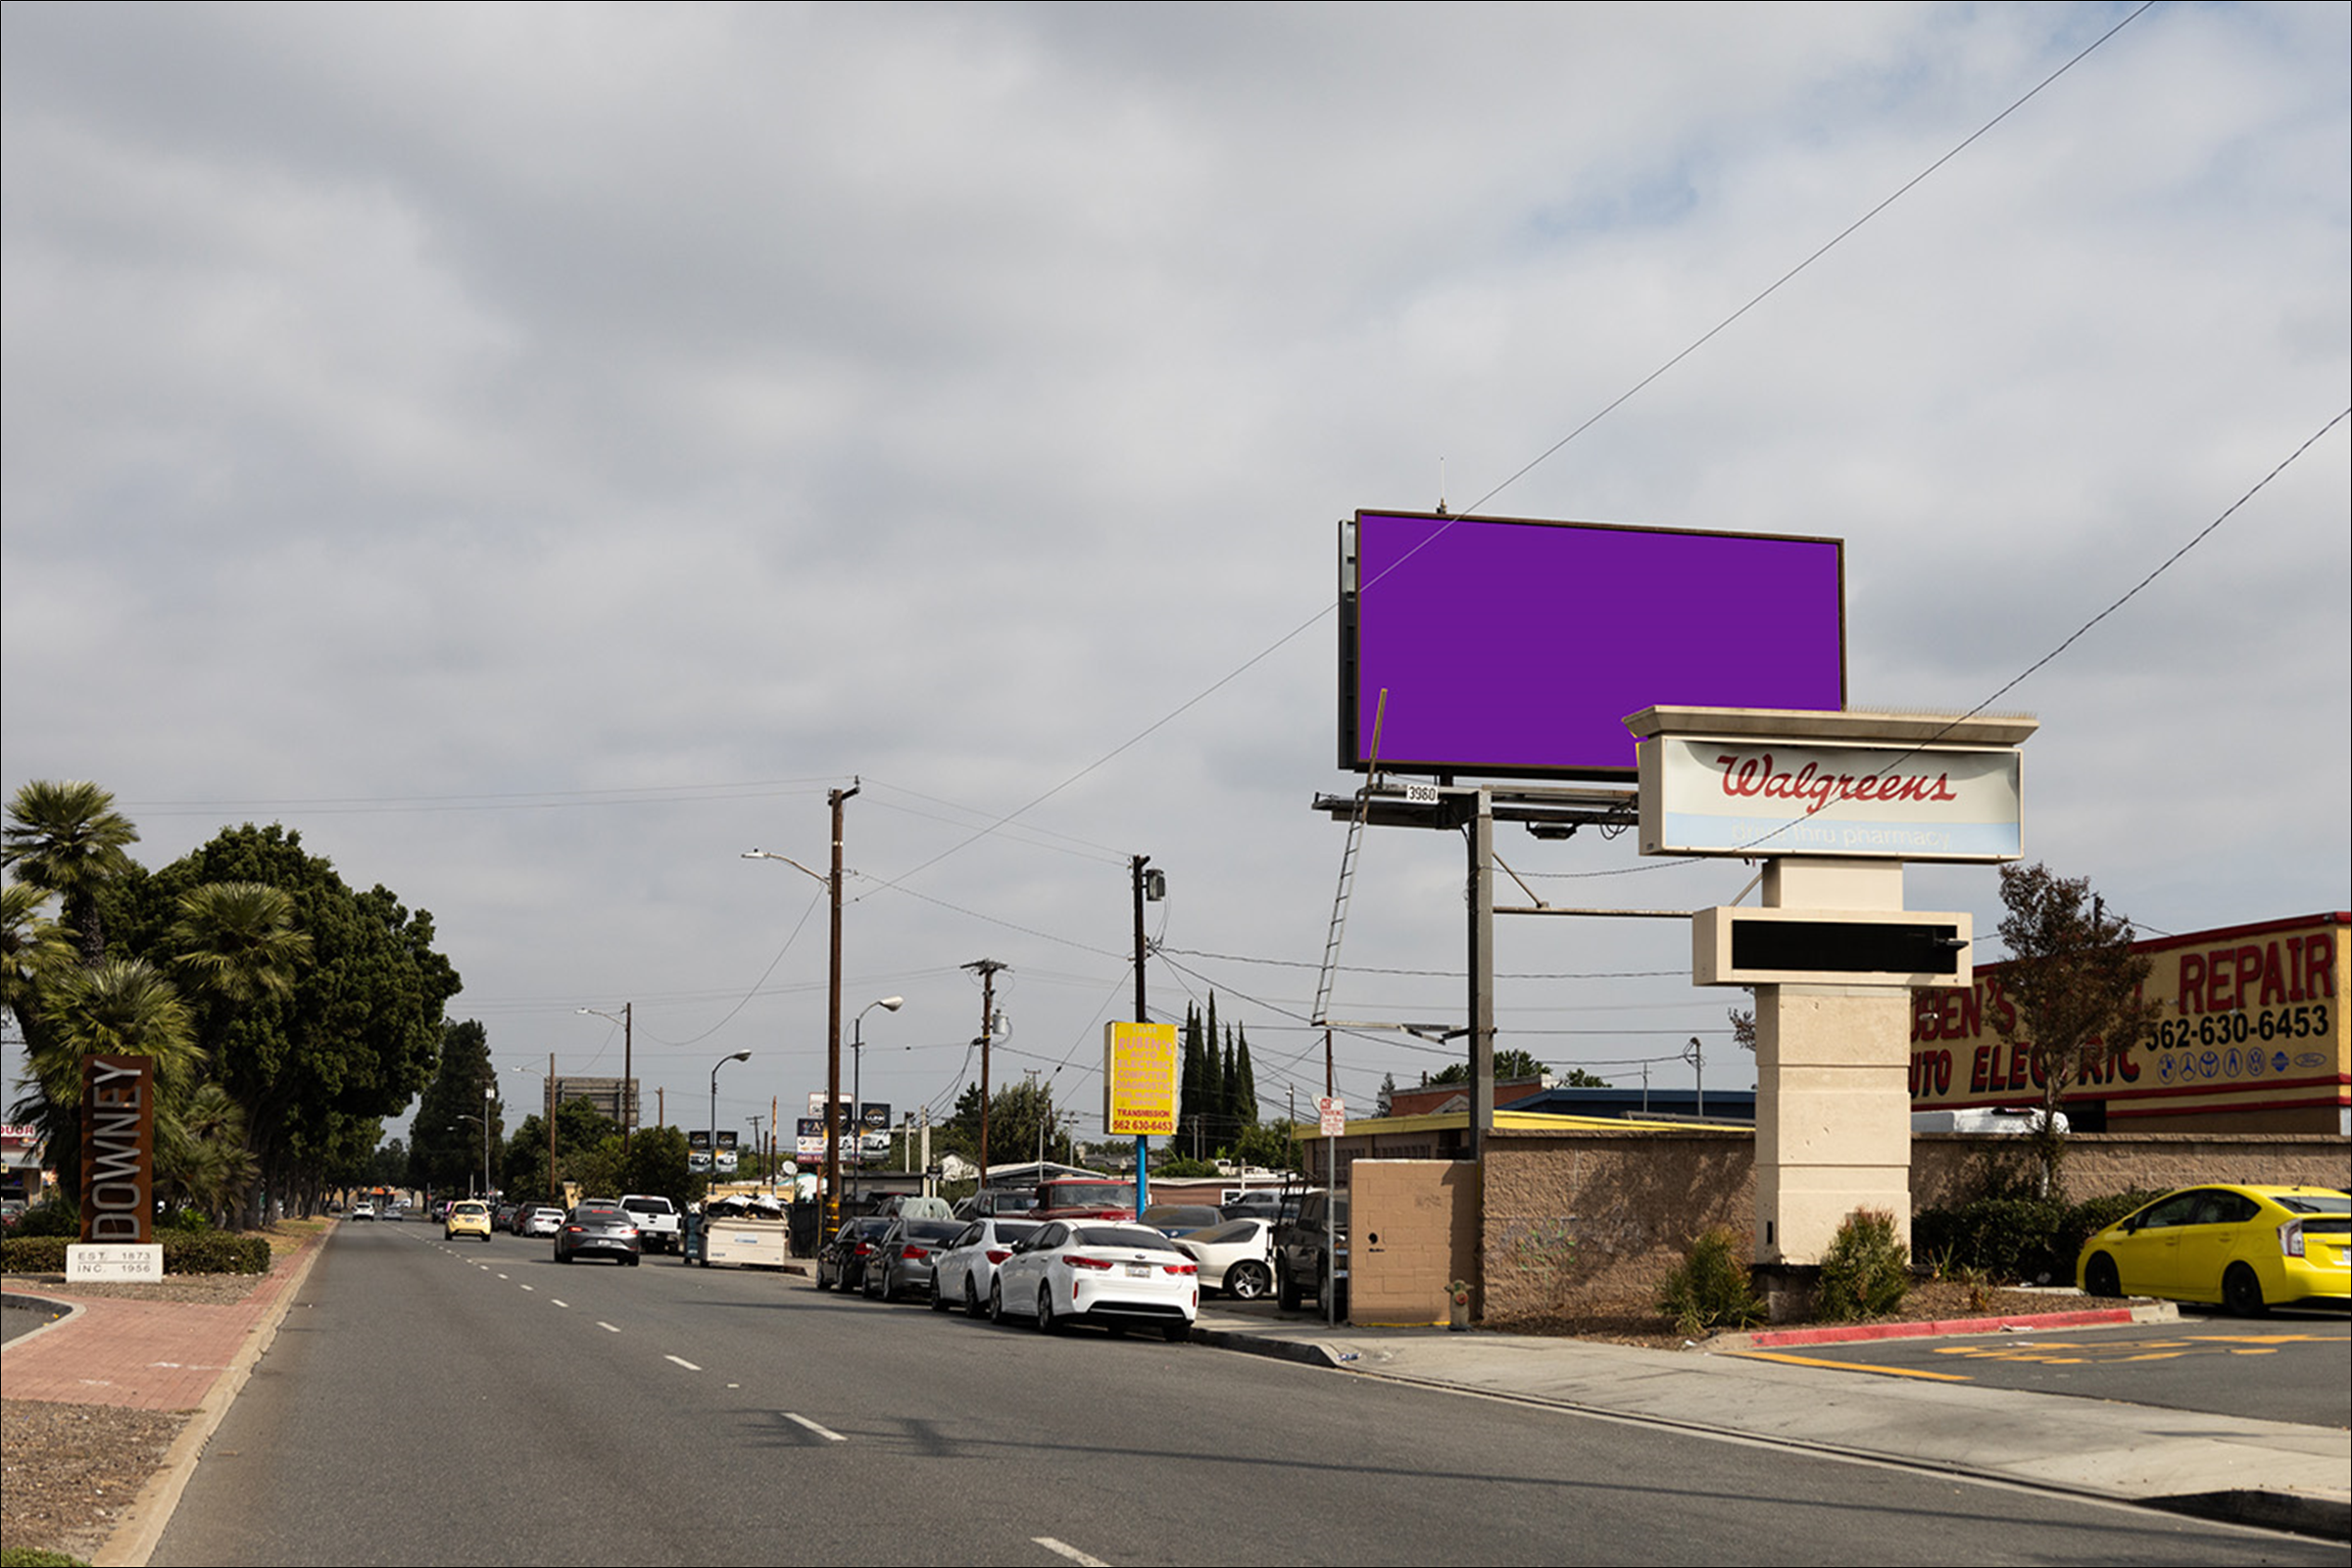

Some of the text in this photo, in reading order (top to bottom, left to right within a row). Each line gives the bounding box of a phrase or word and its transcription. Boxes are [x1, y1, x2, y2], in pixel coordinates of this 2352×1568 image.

[1717, 754, 1957, 814] Walgreens
[1792, 823, 1837, 843] thru
[1844, 825, 1951, 849] pharmacy
[2179, 933, 2336, 1015] REPAIR
[1117, 1036, 1173, 1056] RUBEN'S
[1130, 1050, 1158, 1059] AUTO
[1116, 1058, 1171, 1070] ELECTRIC
[1117, 1069, 1169, 1081] COMPUTER
[1909, 1050, 1952, 1099] UTO
[1115, 1080, 1172, 1092] DIAGNOSTIC
[1116, 1108, 1171, 1118] TRANSMISSION
[1113, 1119, 1173, 1132] 562 630-6453
[91, 1058, 142, 1240] DOWNEY
[122, 1251, 151, 1260] 1873
[77, 1264, 151, 1273] INC. 1956
